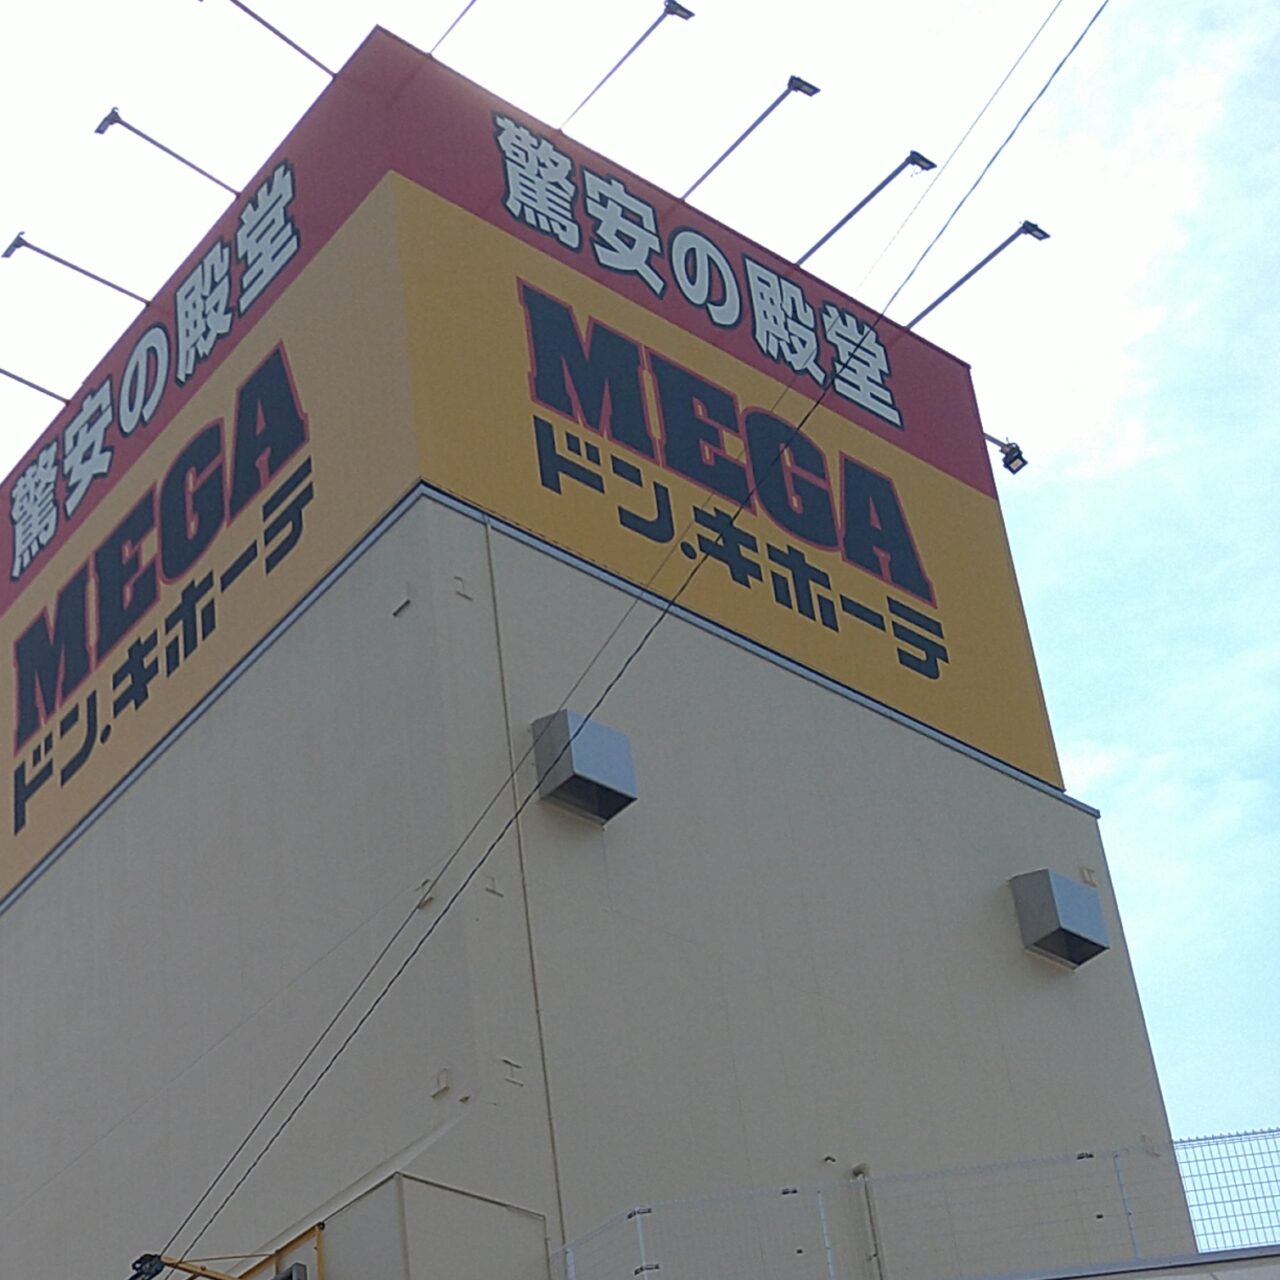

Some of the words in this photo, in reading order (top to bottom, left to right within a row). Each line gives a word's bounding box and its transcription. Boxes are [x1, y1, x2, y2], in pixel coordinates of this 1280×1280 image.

[10, 160, 299, 583] 驚安の殿堂
[493, 112, 904, 430] 驚安の殿堂
[517, 276, 937, 608] MEGA
[13, 339, 310, 757] MEGA
